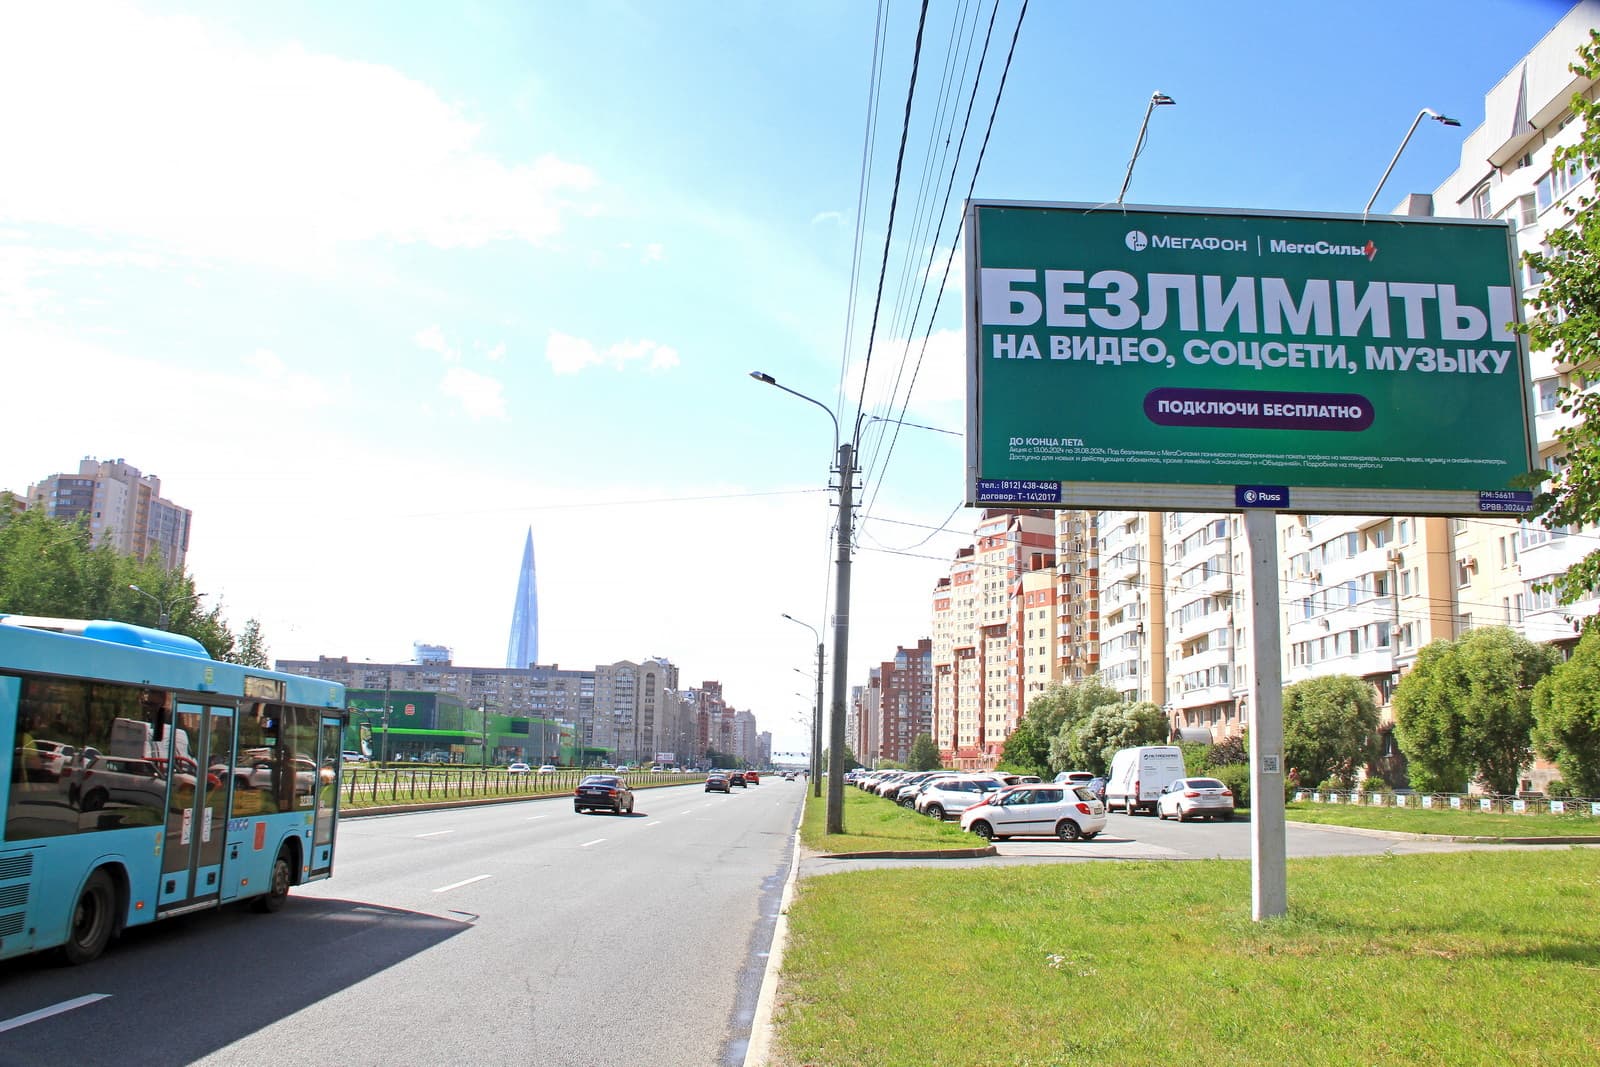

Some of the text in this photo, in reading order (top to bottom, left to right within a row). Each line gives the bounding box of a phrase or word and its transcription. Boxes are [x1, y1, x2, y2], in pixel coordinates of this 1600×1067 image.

[981, 267, 1516, 343] БЕЗЛИМИТЫ
[993, 333, 1512, 375] НА ВИДЕО, СОЦСЕТИ, МУЗЫКУ
[1158, 400, 1362, 420] ПОДКЛЮЧИ БЕСПЛАТНО
[1009, 437, 1084, 447] ДО КОНЦА ЛЕТА
[1002, 481, 1020, 489] (812)
[1259, 492, 1280, 500] Russ
